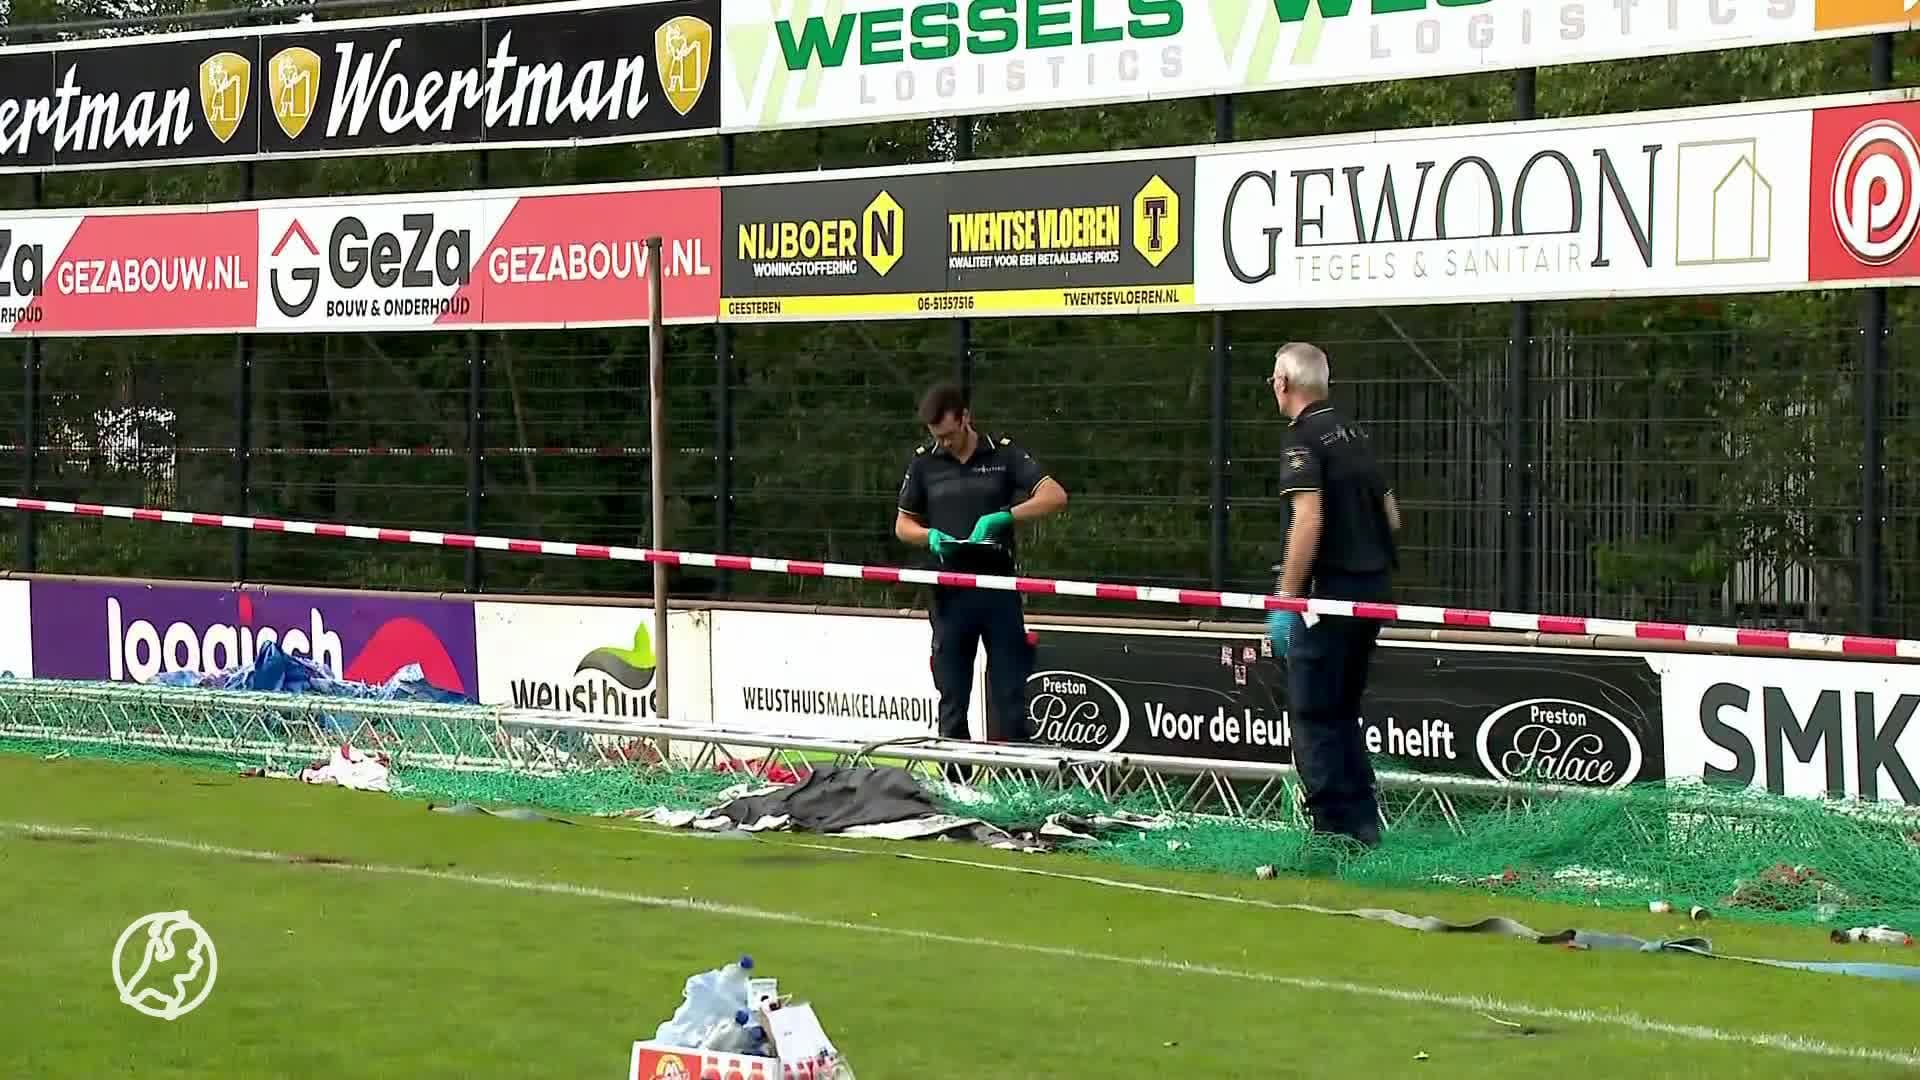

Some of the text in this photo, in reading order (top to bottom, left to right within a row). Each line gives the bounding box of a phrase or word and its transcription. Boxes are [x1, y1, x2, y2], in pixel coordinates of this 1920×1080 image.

[774, 0, 1184, 71] WESSELS
[325, 29, 648, 138] Woertman
[859, 46, 1183, 104] LOGISTICS
[871, 210, 895, 257] N
[949, 206, 1120, 253] TWENTSE VLOEREN
[1144, 196, 1168, 252] T
[1222, 144, 1663, 284] GEWOON
[328, 213, 470, 289] GeZa
[738, 219, 857, 260] NIJBOER
[949, 255, 993, 269] KWALITEIT
[993, 254, 1018, 267] VOOR
[1019, 253, 1036, 266] EEN
[1037, 252, 1093, 265] BETAALBARE
[1295, 242, 1583, 283] TEGELS & SANITAIR
[57, 256, 248, 295] GEZABOUW.NL
[753, 260, 857, 277] WONINGSTOFFERING
[326, 297, 470, 317] BOUW & ONDERHOUD
[728, 301, 781, 315] GEESTEREN
[1063, 290, 1179, 307] TWENTSEVLOEREN.NL
[1042, 676, 1087, 695] Preston
[1027, 693, 1109, 746] Palace
[1144, 702, 1203, 741] Voor
[1208, 706, 1240, 744] de
[1387, 718, 1456, 760] helft
[1530, 705, 1587, 727] Preston
[1502, 724, 1616, 784] Palace
[1699, 682, 1920, 806] SMK
